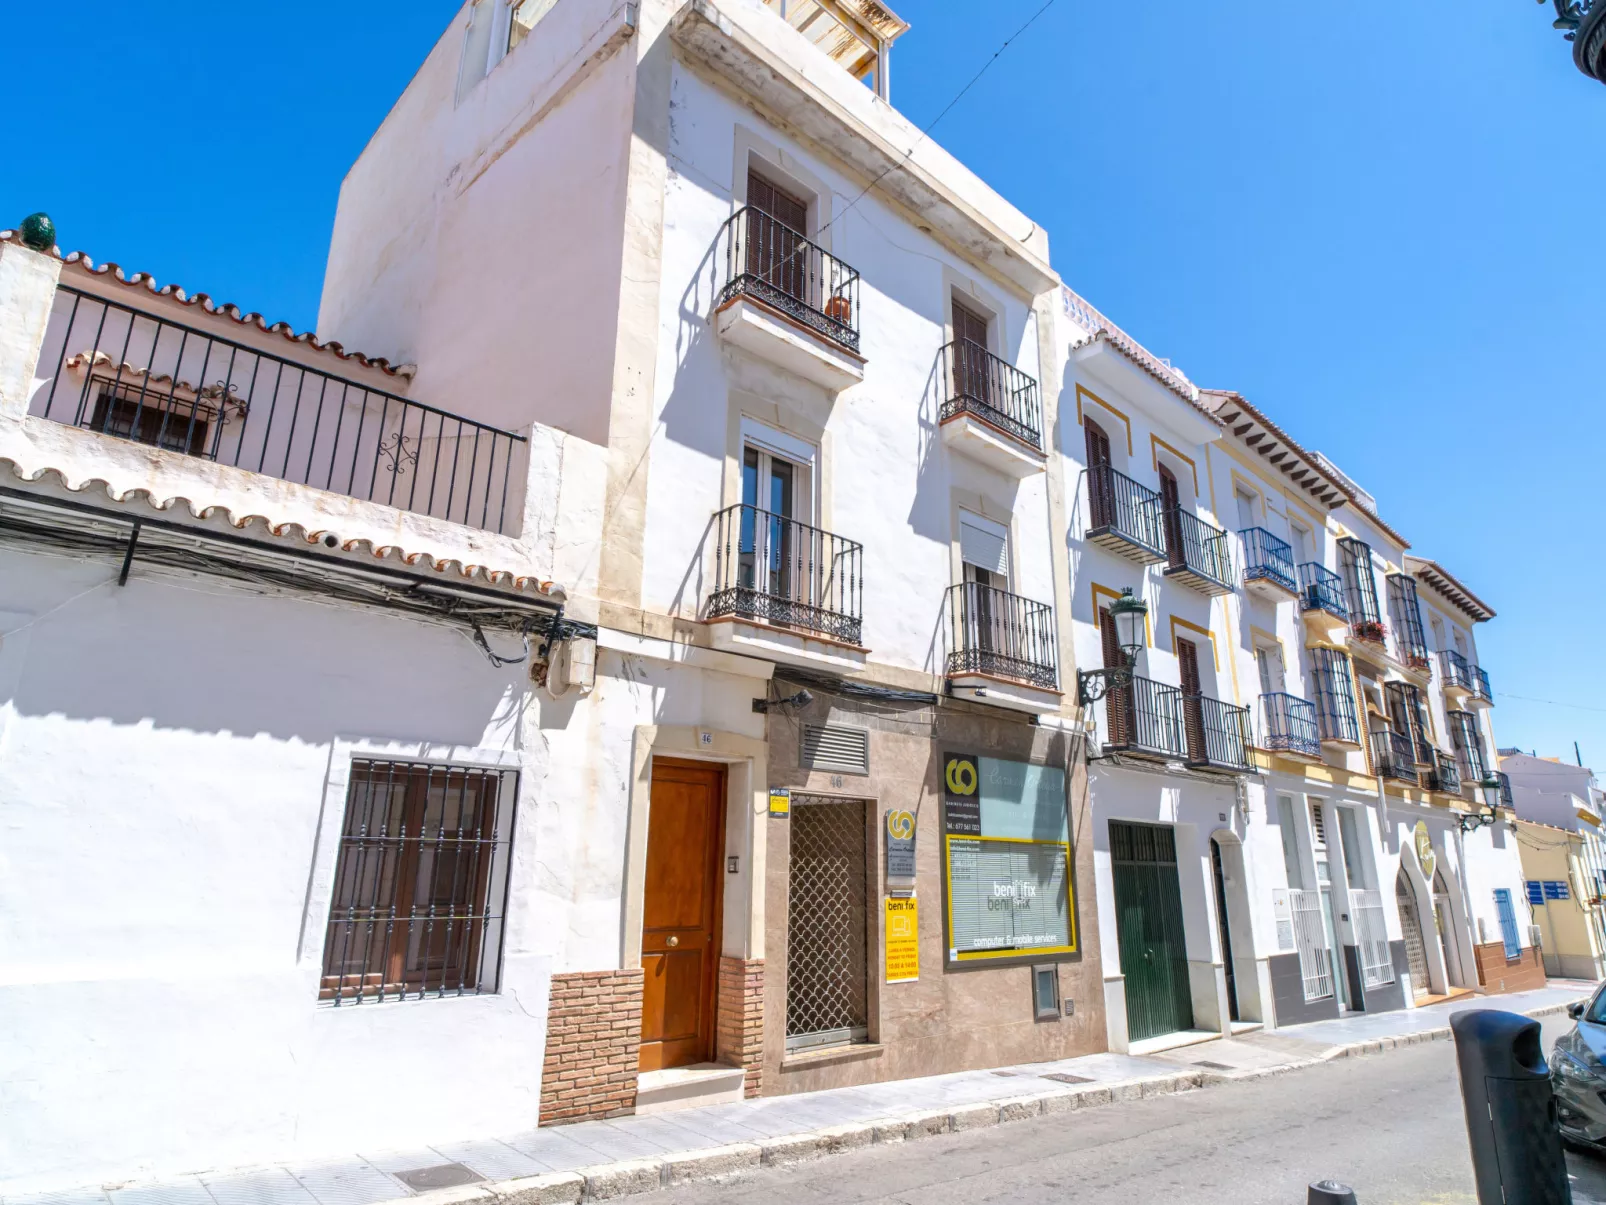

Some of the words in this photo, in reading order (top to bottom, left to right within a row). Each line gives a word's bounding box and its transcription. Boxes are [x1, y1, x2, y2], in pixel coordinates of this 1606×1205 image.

[701, 734, 711, 743] 46
[830, 775, 842, 789] 46
[888, 902, 904, 911] beni
[905, 901, 915, 910] fix
[973, 936, 1005, 947] computer
[1006, 935, 1013, 945] &
[1013, 934, 1034, 945] mobile
[1034, 932, 1057, 944] services
